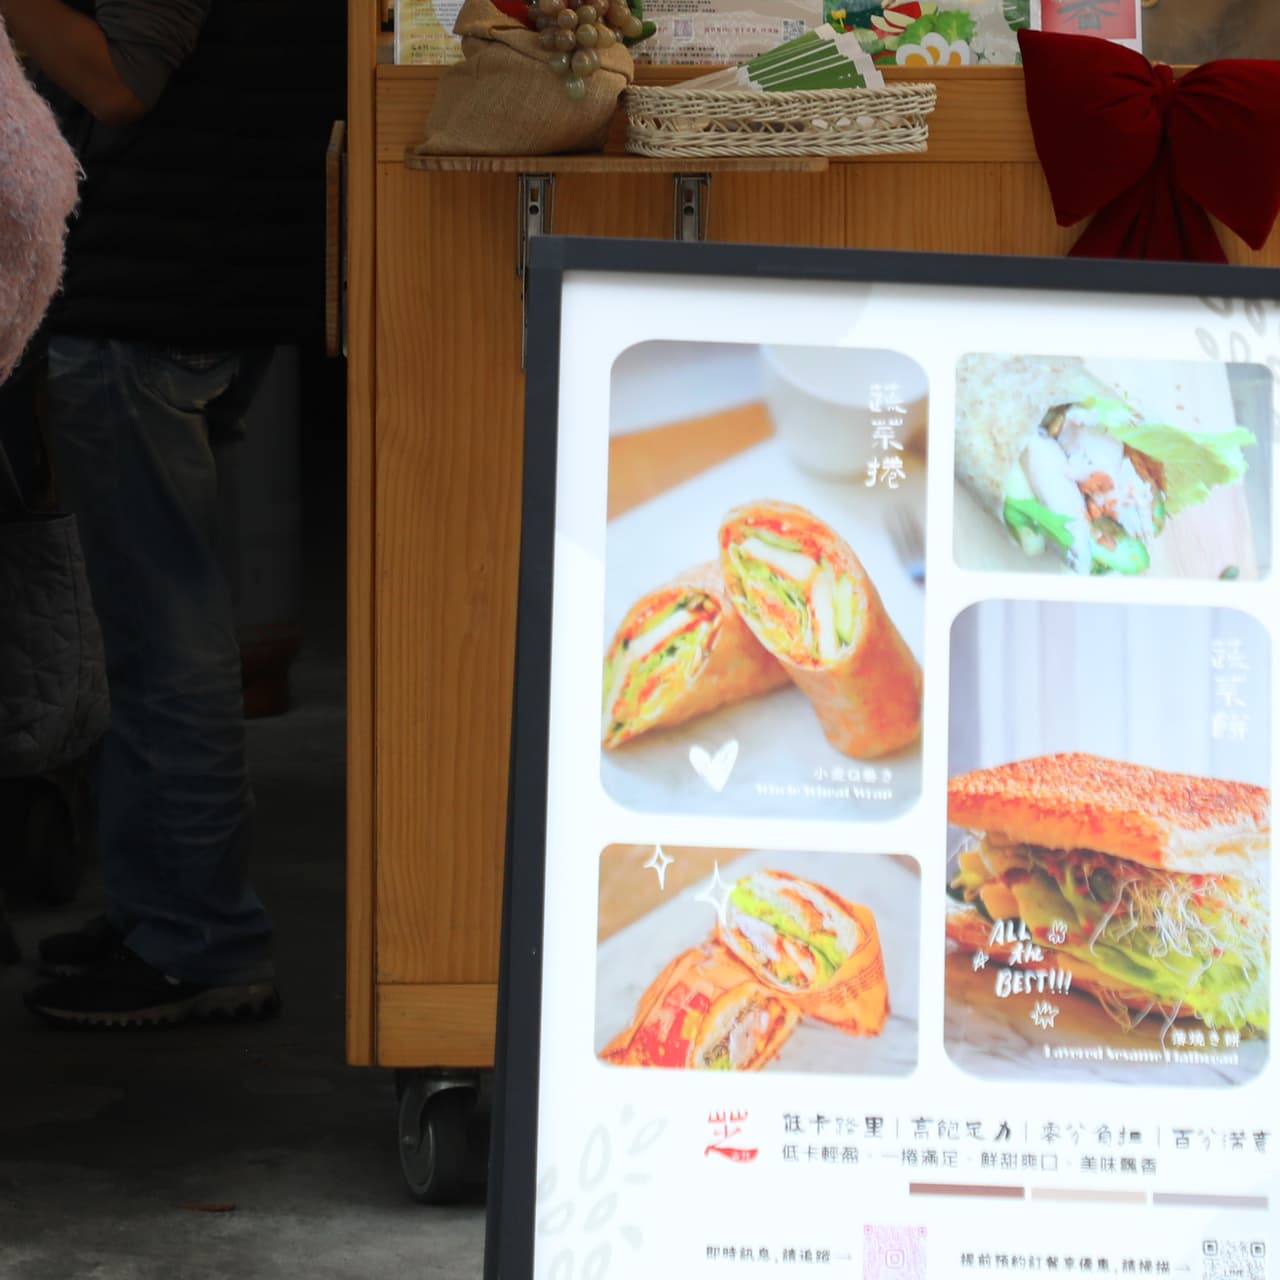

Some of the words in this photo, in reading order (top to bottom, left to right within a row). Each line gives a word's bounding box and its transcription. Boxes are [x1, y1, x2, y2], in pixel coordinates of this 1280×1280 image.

[864, 383, 907, 489] 蔬菜捲
[988, 920, 1031, 947] ALL
[1008, 942, 1044, 966] the
[995, 970, 1072, 998] BEST!!!
[1080, 1155, 1158, 1176] 美味飄香
